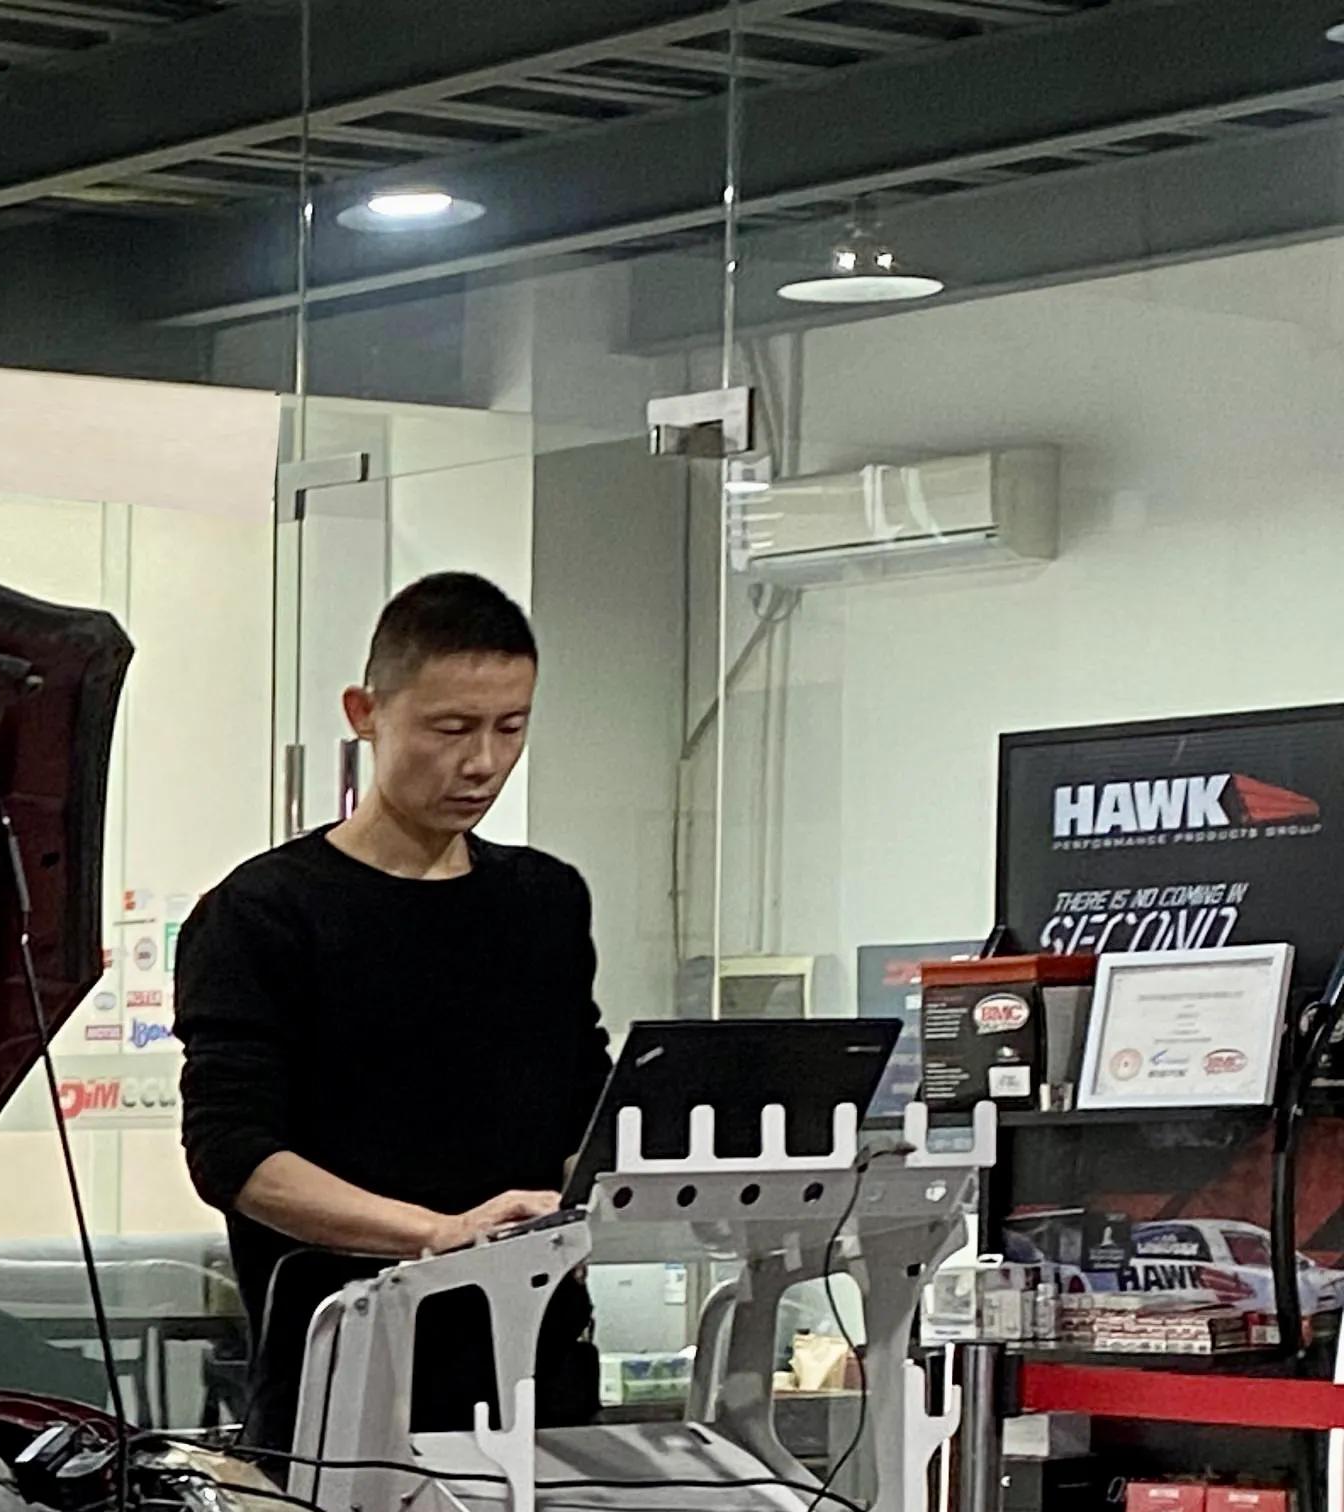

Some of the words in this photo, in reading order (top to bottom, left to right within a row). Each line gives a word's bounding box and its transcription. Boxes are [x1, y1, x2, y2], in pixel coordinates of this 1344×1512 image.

[1054, 774, 1231, 837] HAWK
[1173, 827, 1258, 843] PRODUCTS
[1054, 890, 1111, 912] THERE
[1108, 889, 1131, 910] IS
[1130, 887, 1159, 908] NO
[1158, 883, 1227, 907] COMING
[1226, 882, 1249, 904] IN
[1040, 907, 1239, 956] SECOND
